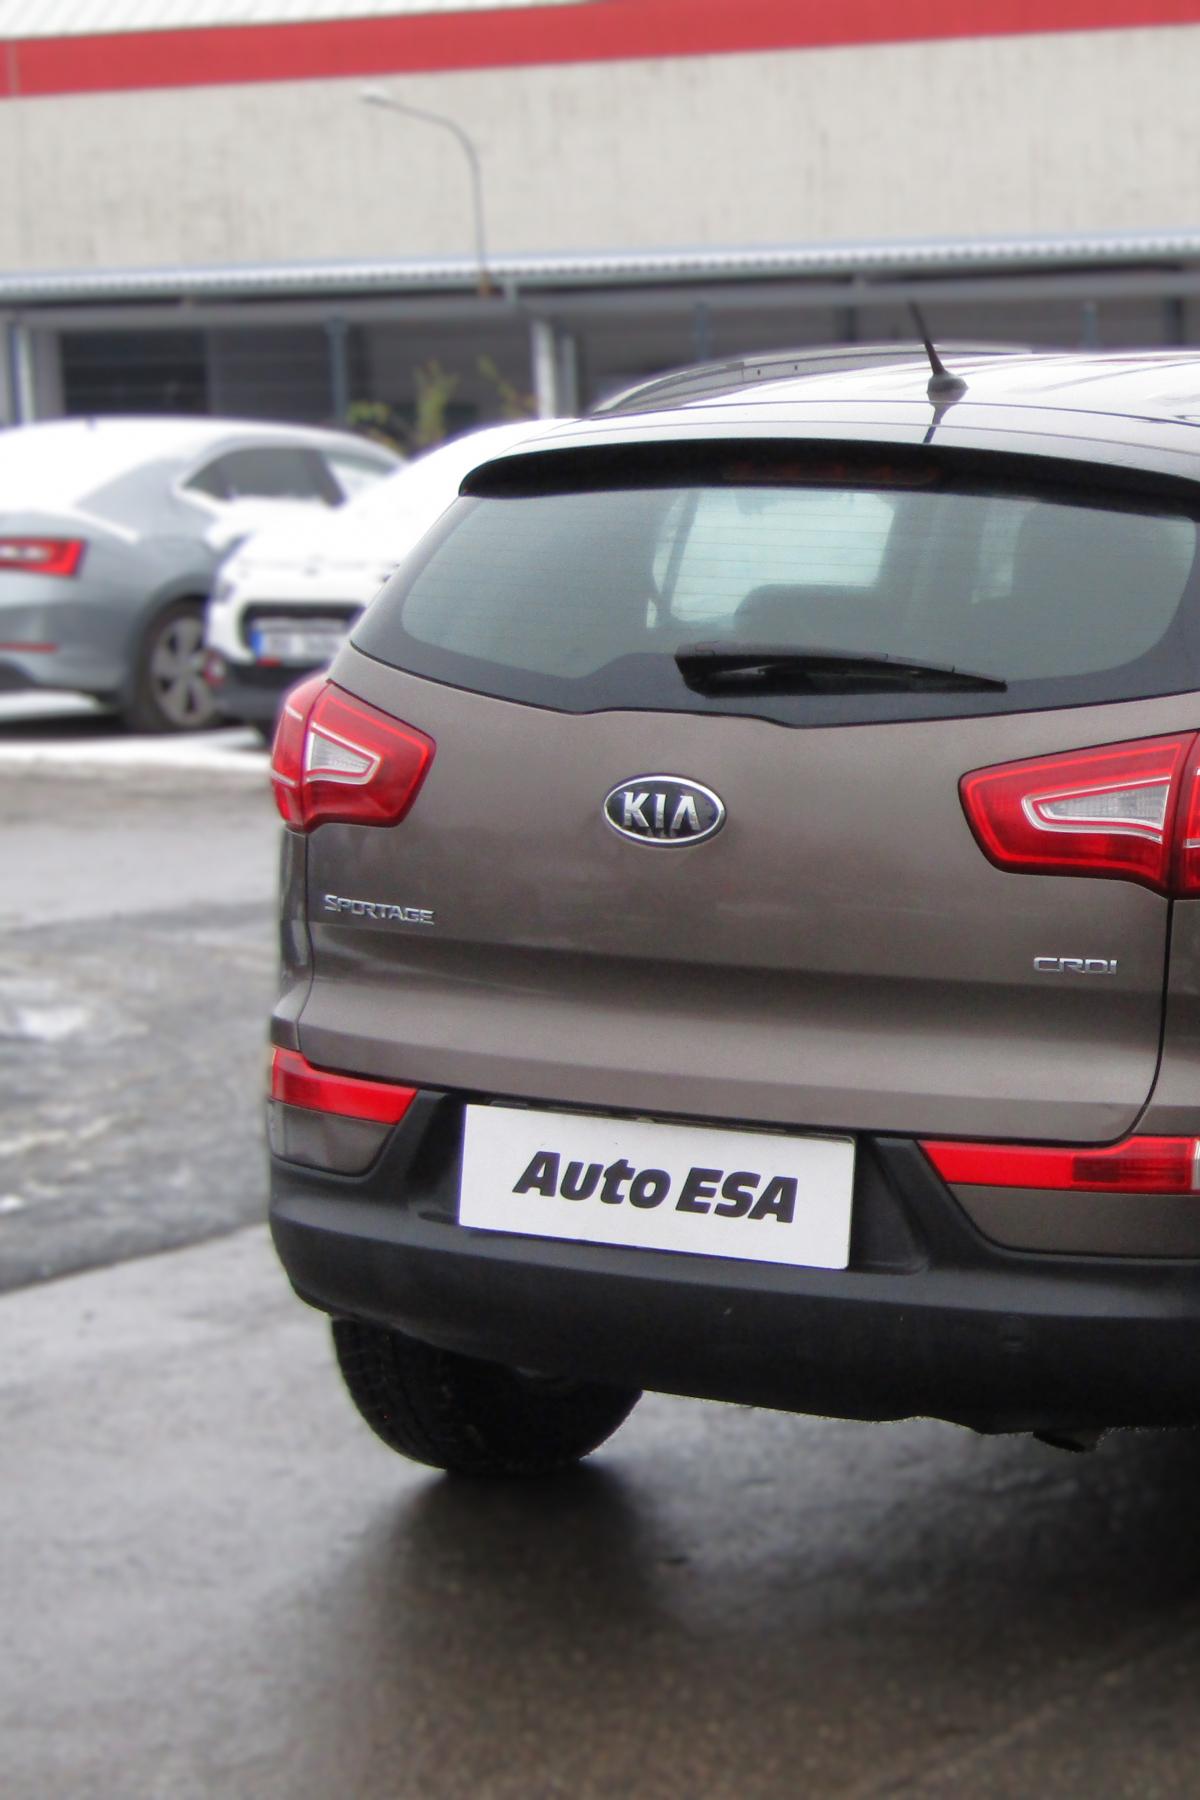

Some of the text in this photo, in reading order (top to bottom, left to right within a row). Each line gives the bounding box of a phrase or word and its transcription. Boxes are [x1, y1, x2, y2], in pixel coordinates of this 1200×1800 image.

[623, 791, 701, 831] KIA
[324, 894, 435, 925] SPORTAGE
[512, 1151, 798, 1223] Auto ESA
